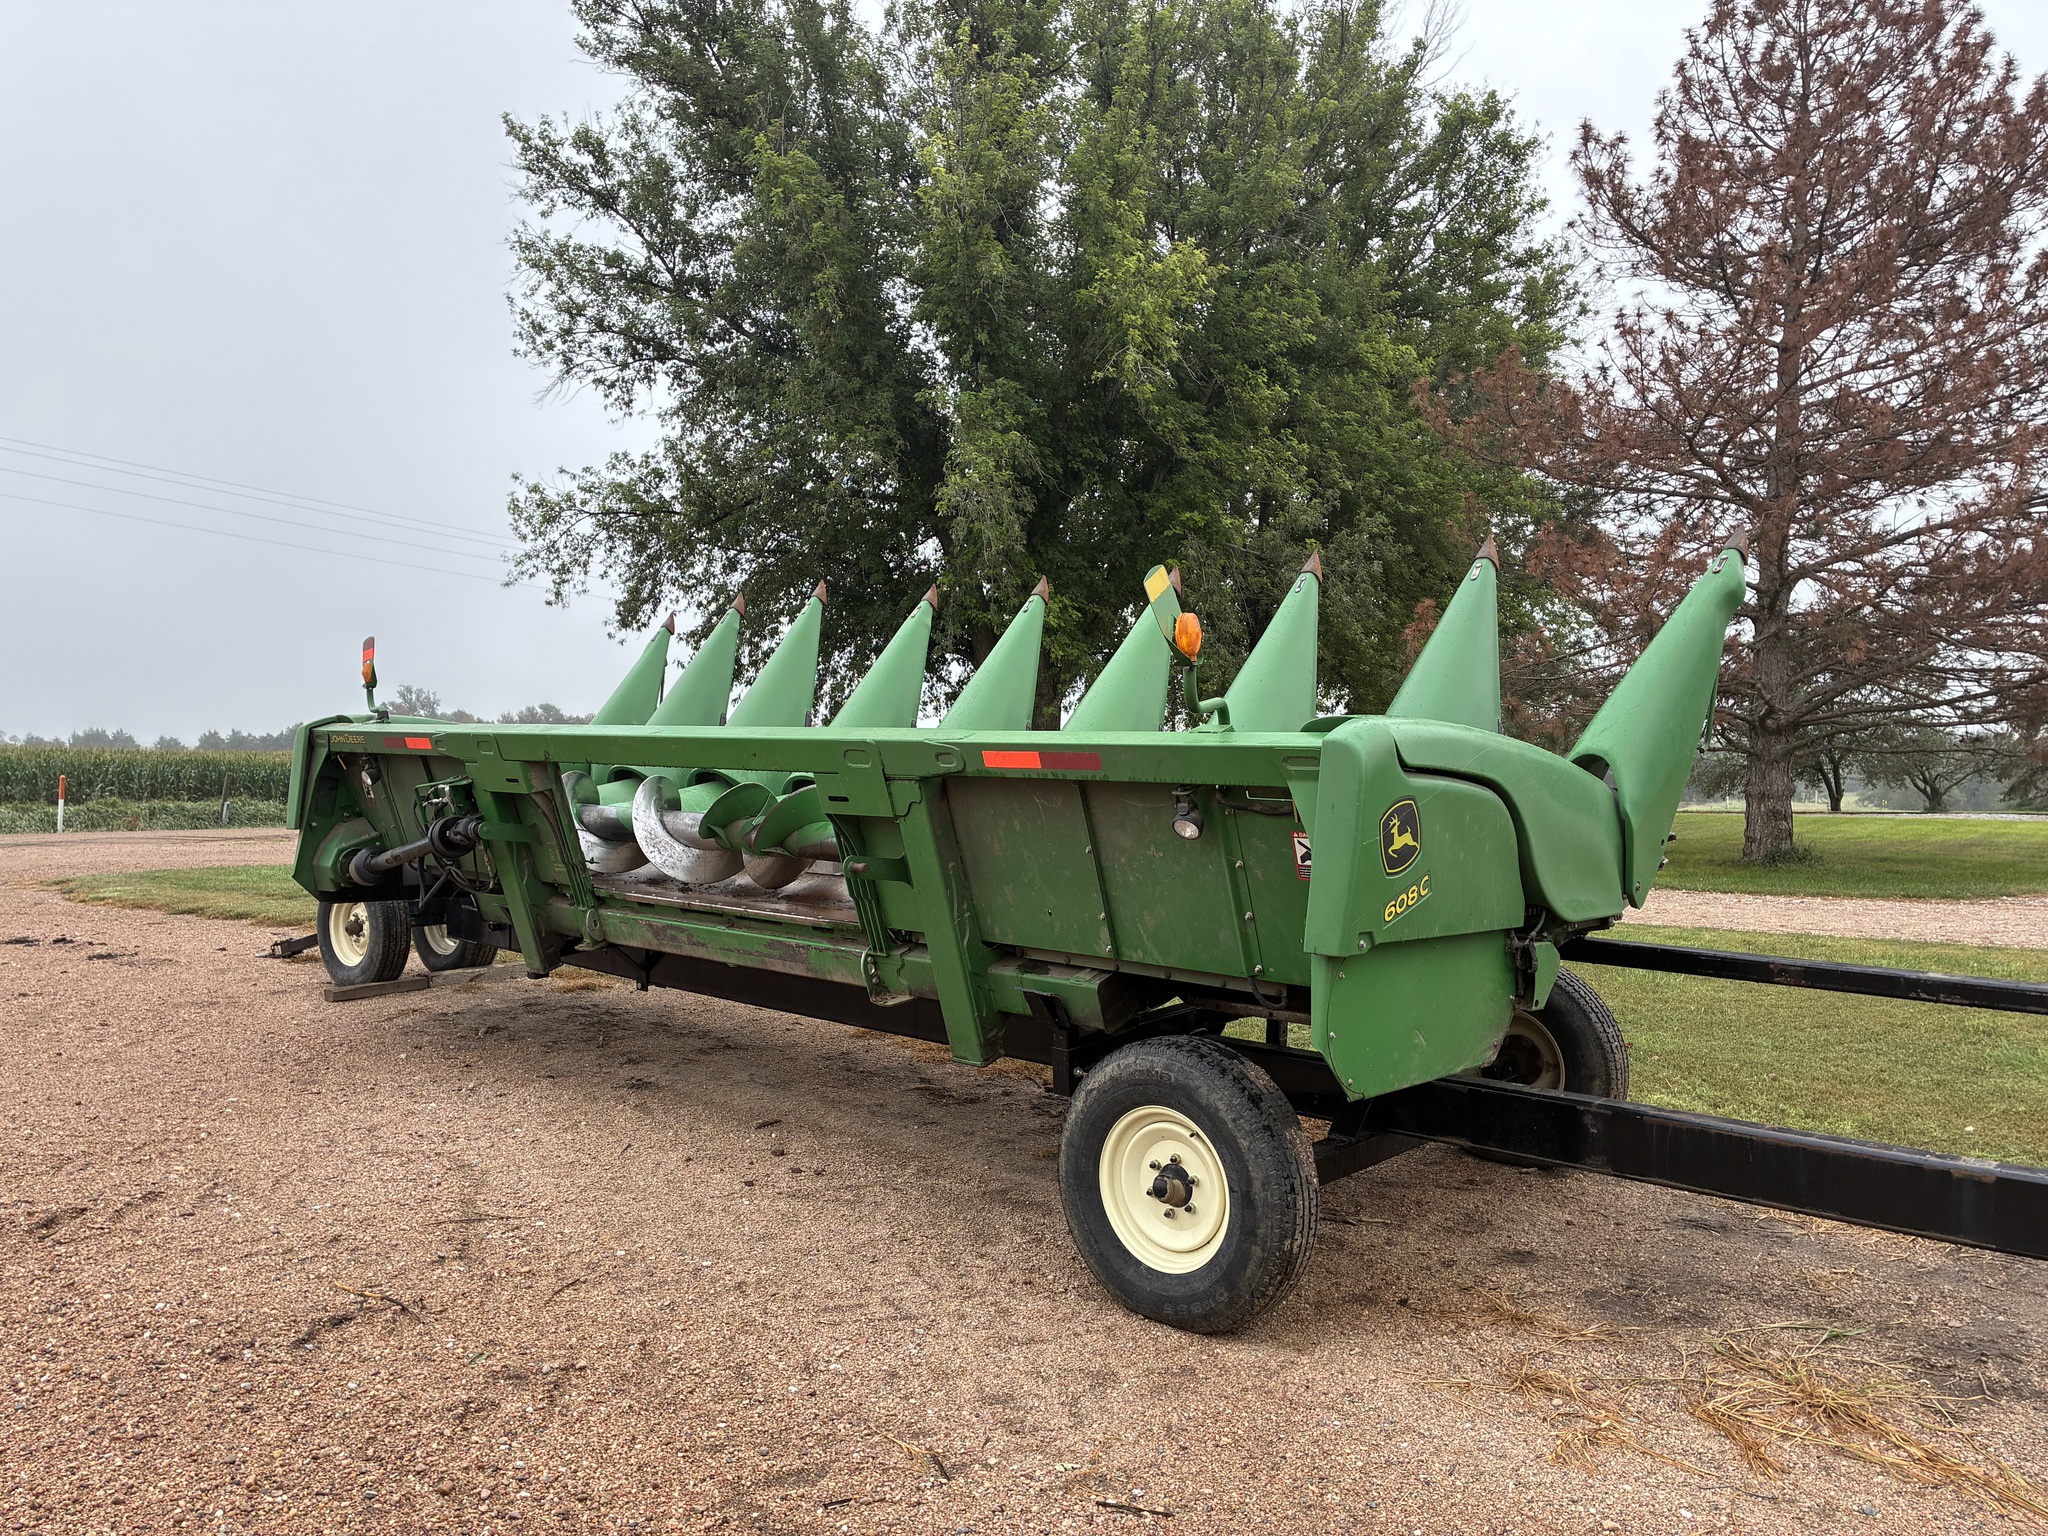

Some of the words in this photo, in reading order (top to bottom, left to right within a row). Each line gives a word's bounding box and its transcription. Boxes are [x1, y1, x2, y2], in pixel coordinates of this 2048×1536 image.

[330, 734, 346, 743] JOHN
[345, 733, 365, 744] DEERE
[1384, 875, 1429, 922] 608C
